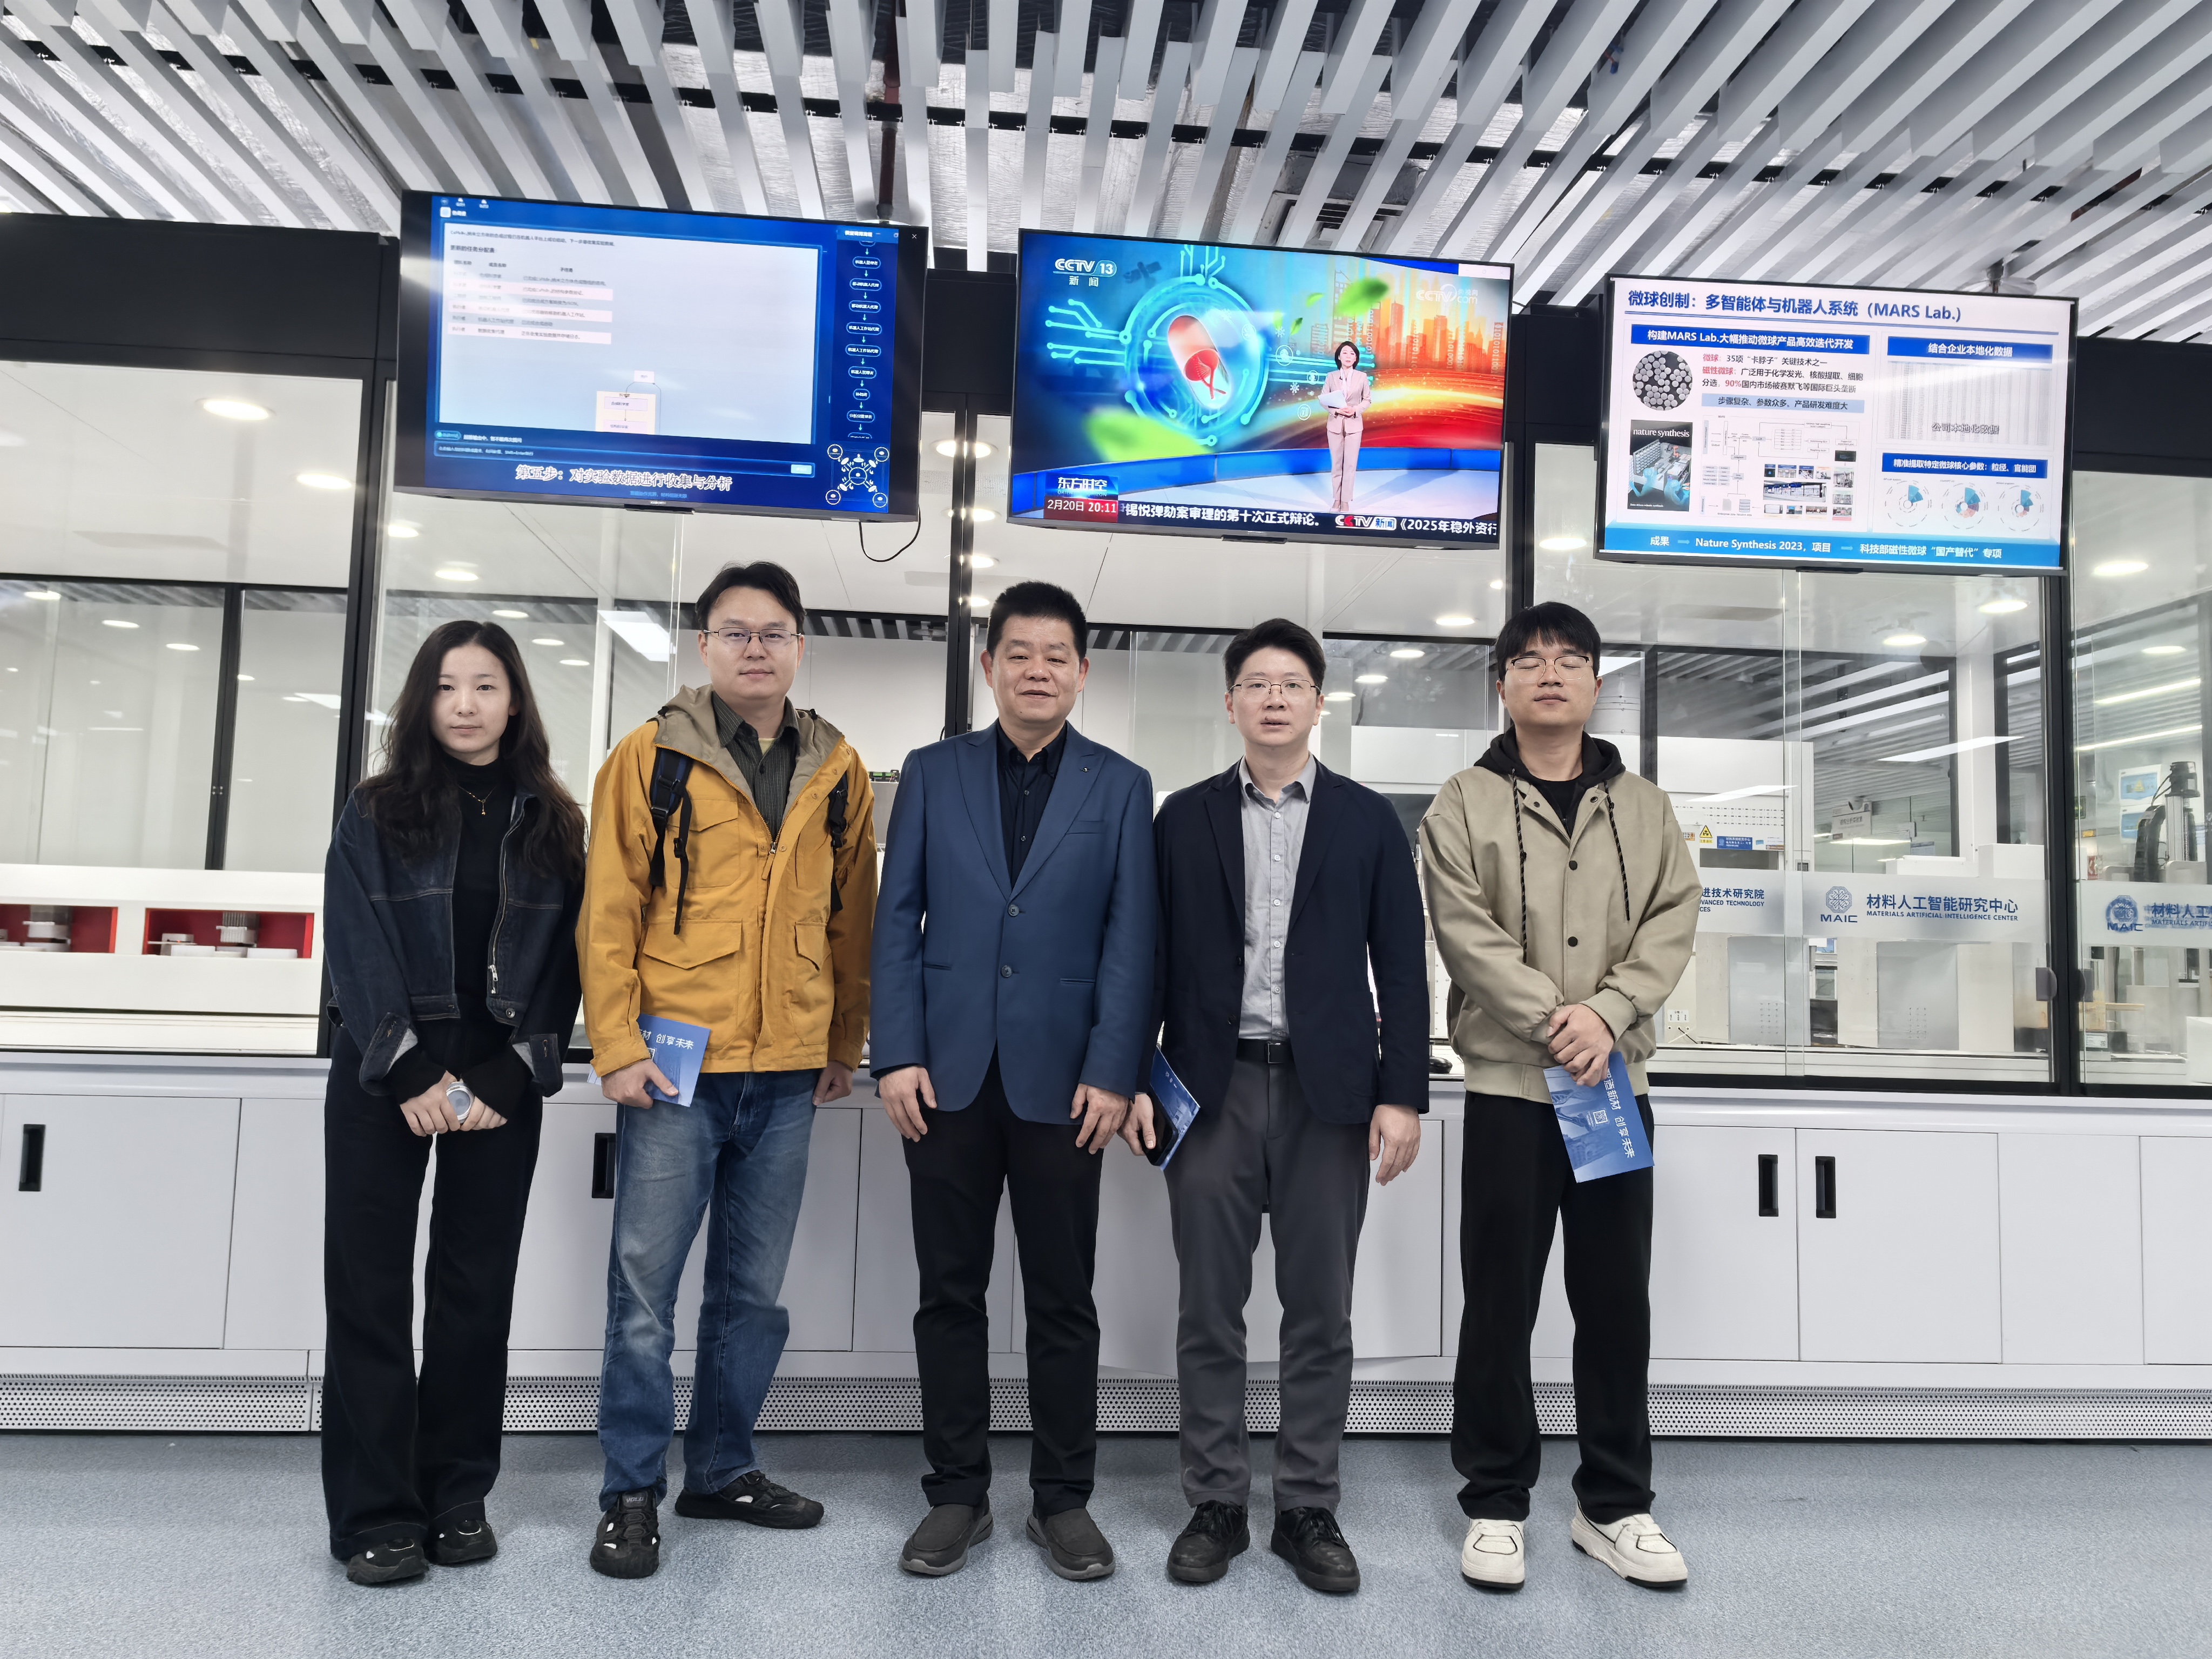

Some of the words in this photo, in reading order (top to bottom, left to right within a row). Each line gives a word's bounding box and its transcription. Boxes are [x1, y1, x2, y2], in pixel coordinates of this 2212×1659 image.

[1055, 258, 1095, 272] CCTV
[1100, 263, 1113, 274] 13
[1069, 275, 1099, 287] 新闻
[1415, 289, 1453, 302] CCTV
[1647, 329, 1697, 341] 构建MARS
[1928, 342, 2013, 358] 结合企业本地化数据
[1718, 396, 1849, 410] 步骤复杂、参数众多、产品研发难度大
[1633, 428, 1657, 436] nature
[1657, 429, 1690, 438] synthesis
[1931, 422, 2000, 435] 公司本地化数据
[515, 464, 733, 491] 第五步：对实验数据进行收集与分析
[1057, 477, 1108, 491] 东方时空
[1047, 499, 1084, 512] 2月20日
[1088, 502, 1117, 513] 20:11
[1336, 515, 1372, 528] CCTV
[1375, 517, 1394, 529] 新闻
[1650, 536, 1670, 547] 成果
[1695, 537, 1729, 548] Nature
[1731, 539, 1777, 551] Synthesis
[1866, 893, 2019, 913] 材料人工智能研究中心
[1820, 914, 1858, 923] MAIC
[2107, 922, 2143, 932] MAIC
[656, 1033, 694, 1050] 创享未来
[1614, 1116, 1635, 1158] 创享未来
